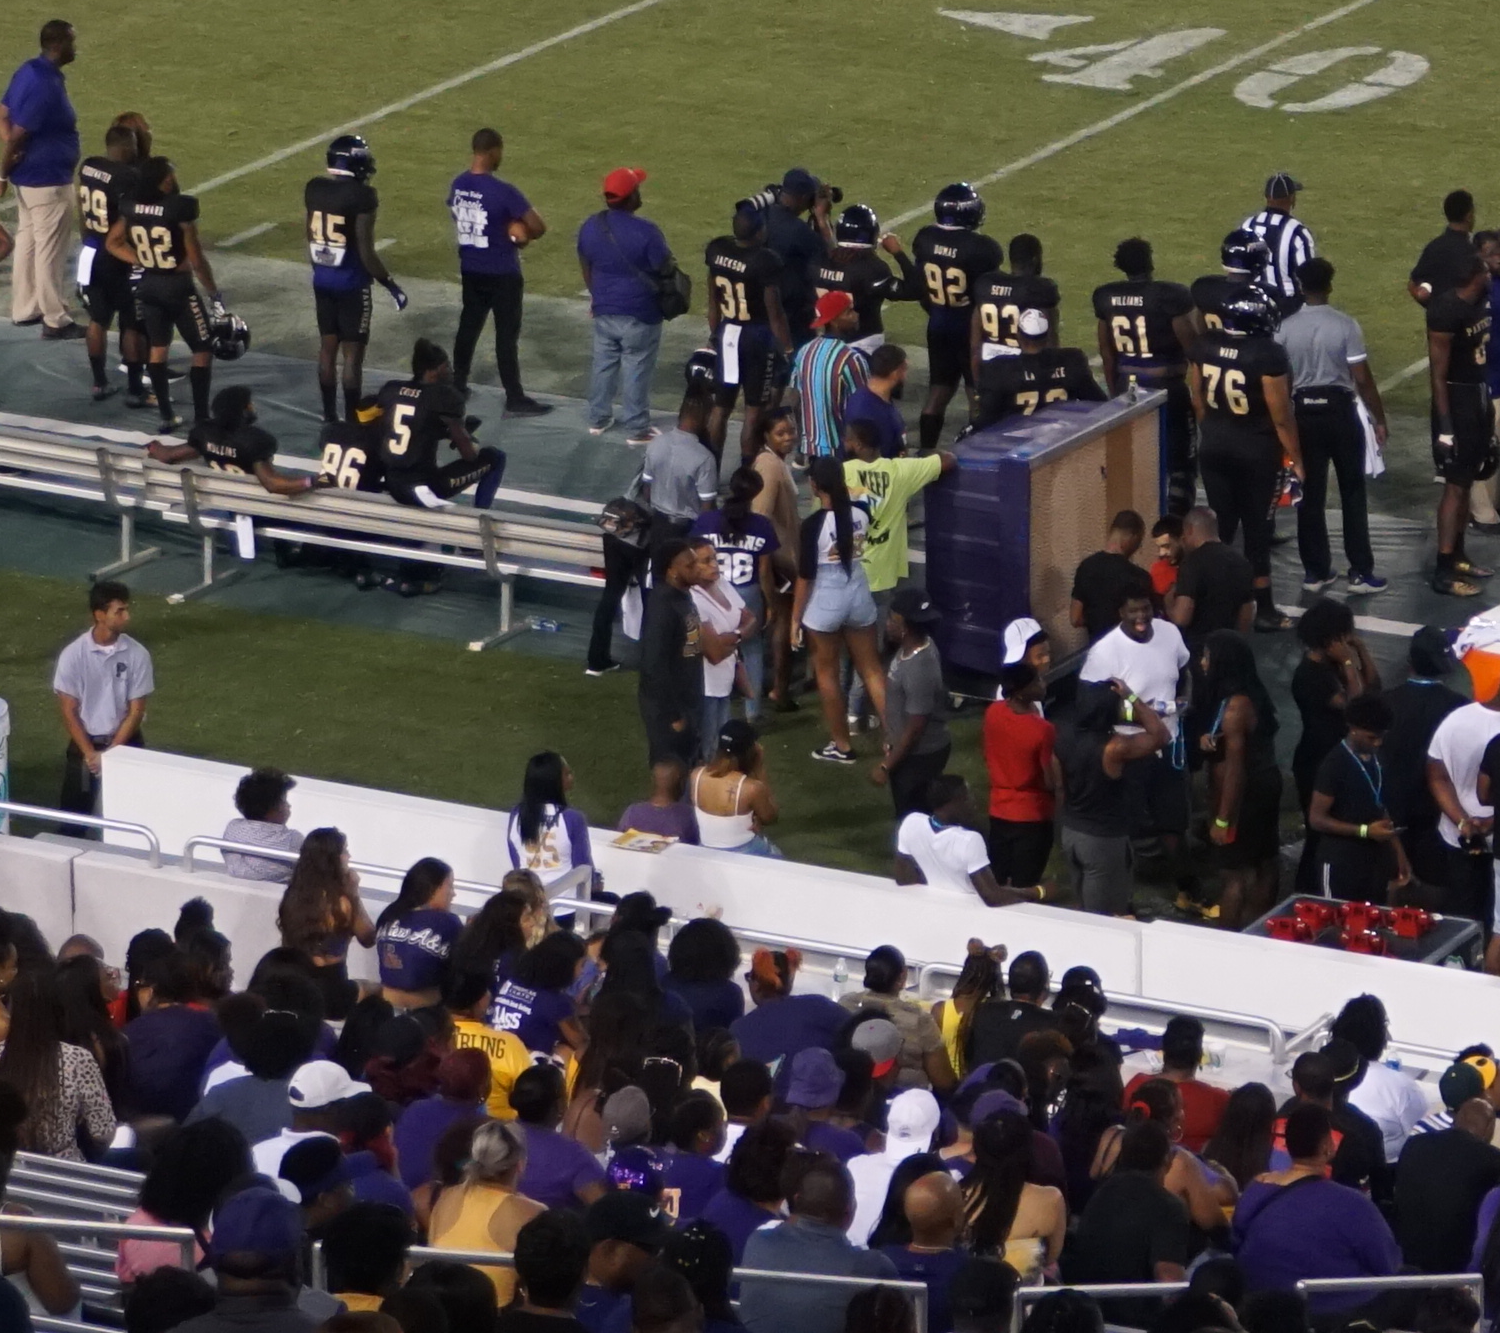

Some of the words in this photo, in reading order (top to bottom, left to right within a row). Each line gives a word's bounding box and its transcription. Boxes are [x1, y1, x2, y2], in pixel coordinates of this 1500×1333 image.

[129, 225, 176, 270] 82
[715, 254, 748, 273] JACKSON
[715, 276, 751, 321] 31
[924, 264, 970, 307] 92
[1111, 295, 1144, 307] WILLIAMS
[1112, 315, 1153, 360] 61
[1220, 346, 1239, 360] WARD
[1202, 366, 1250, 416] 76
[388, 404, 416, 456] 5
[113, 660, 129, 680] P
